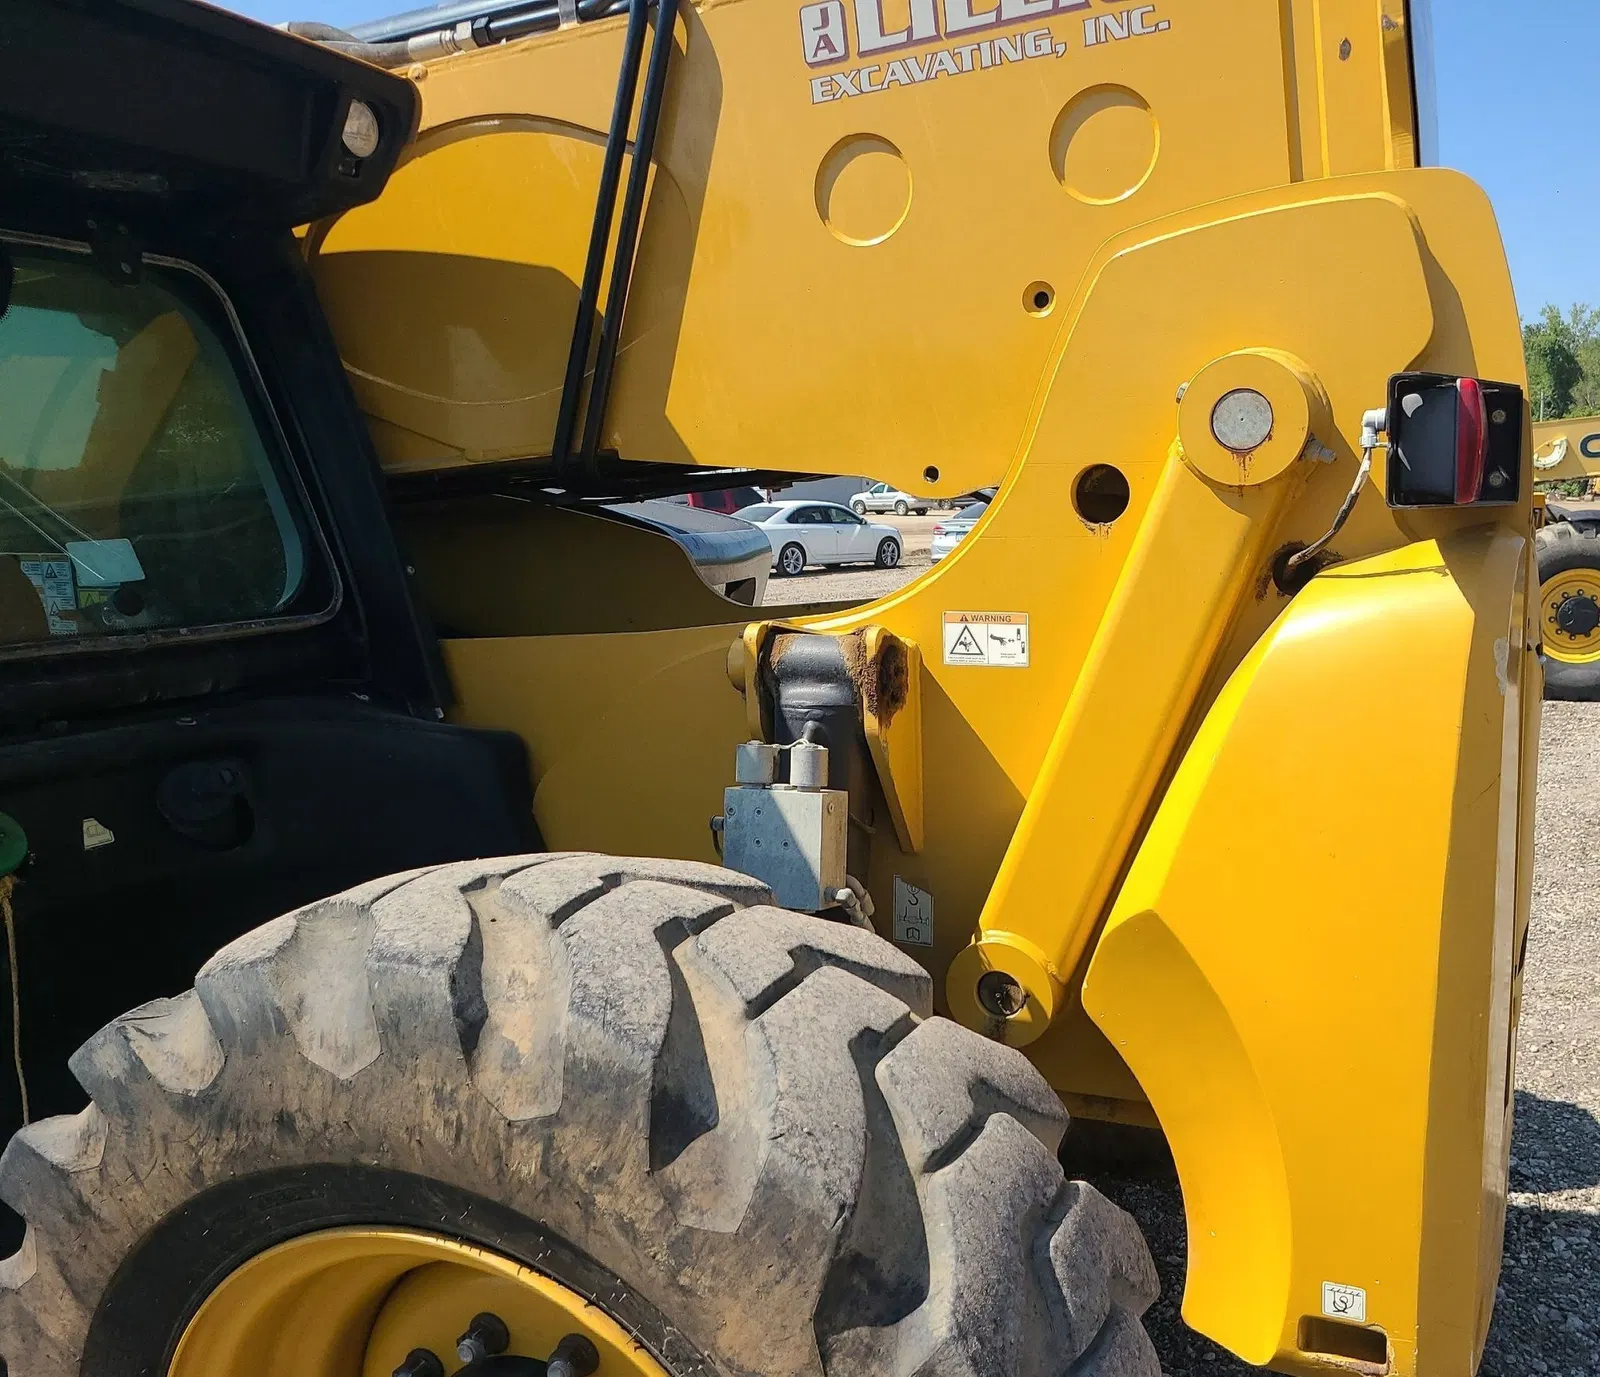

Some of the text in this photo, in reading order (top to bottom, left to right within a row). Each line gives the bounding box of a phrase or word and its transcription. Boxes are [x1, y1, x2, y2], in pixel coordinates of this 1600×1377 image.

[809, 4, 1171, 105] EXCAVATING, INC.
[970, 614, 1012, 623] WARNING
